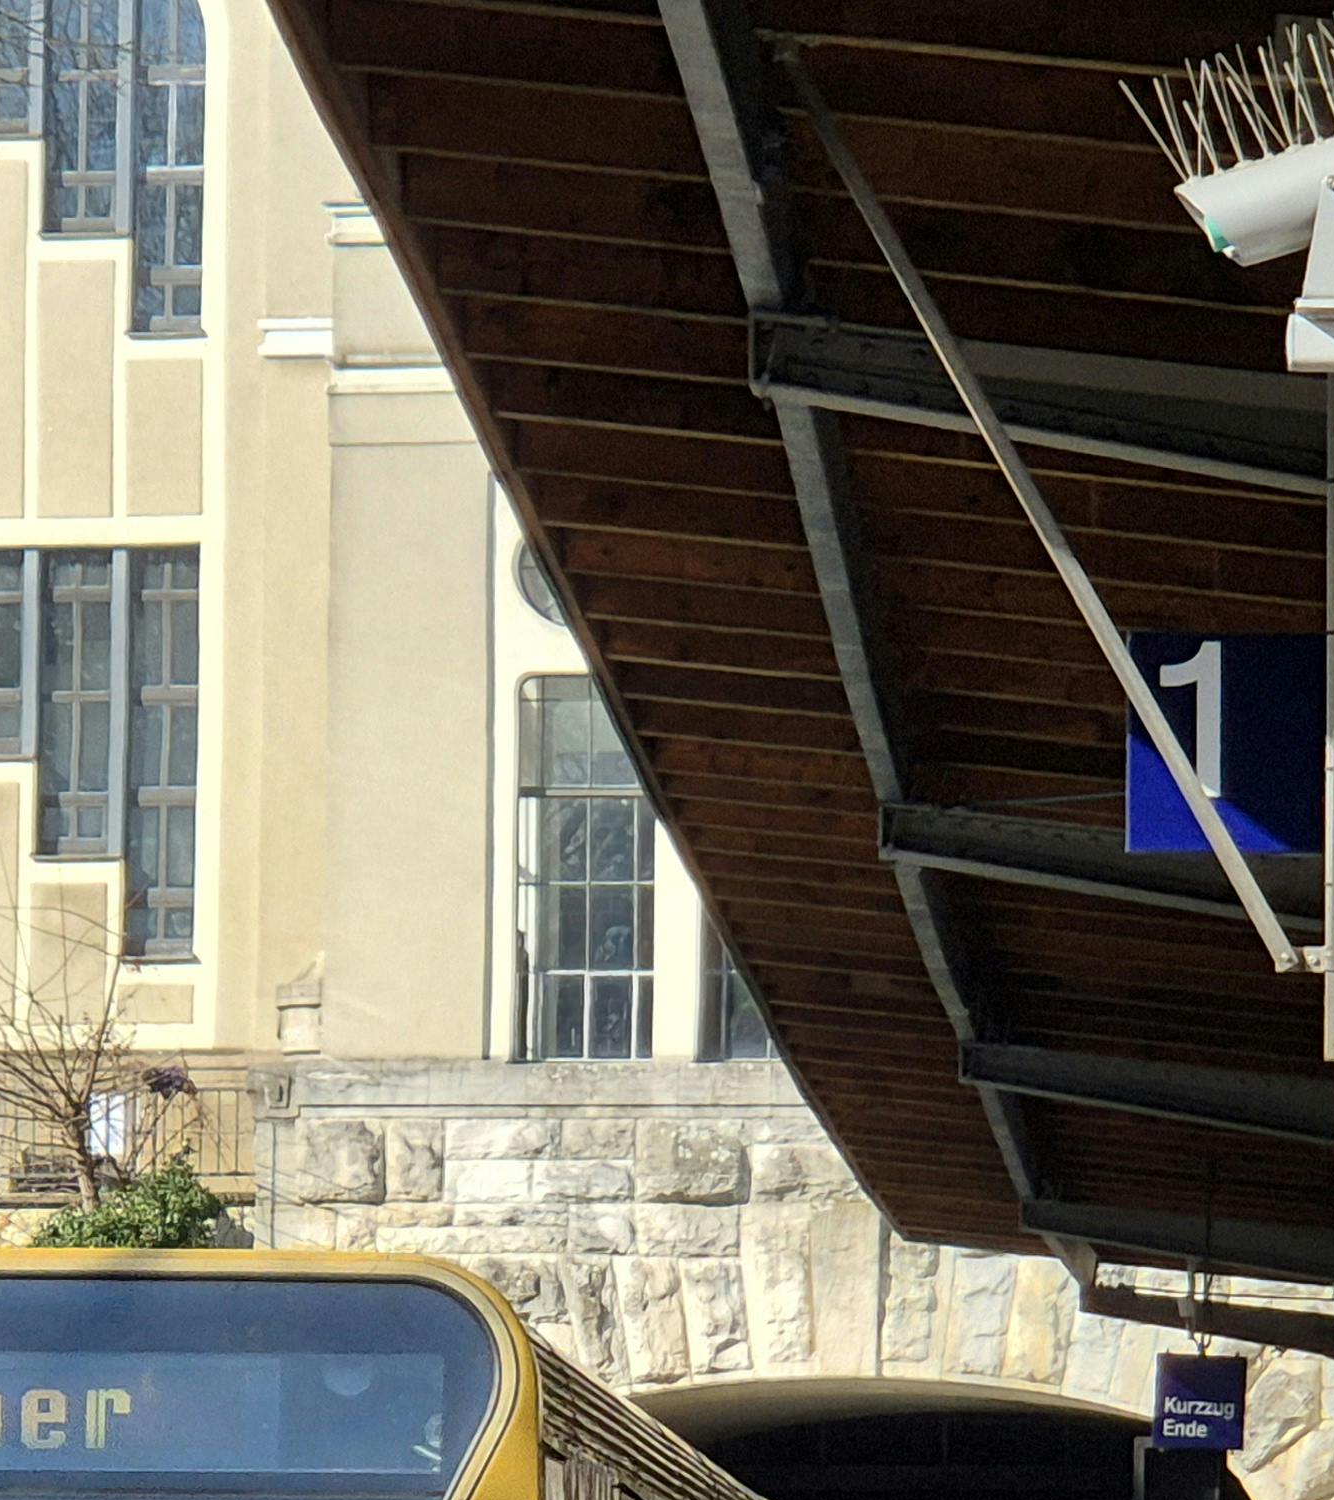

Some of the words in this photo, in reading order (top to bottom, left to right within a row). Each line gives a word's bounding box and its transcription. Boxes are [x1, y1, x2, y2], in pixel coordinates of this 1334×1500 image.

[1159, 640, 1222, 799] 1
[1163, 1396, 1236, 1420] Kurzzug
[1162, 1418, 1208, 1438] Ende
